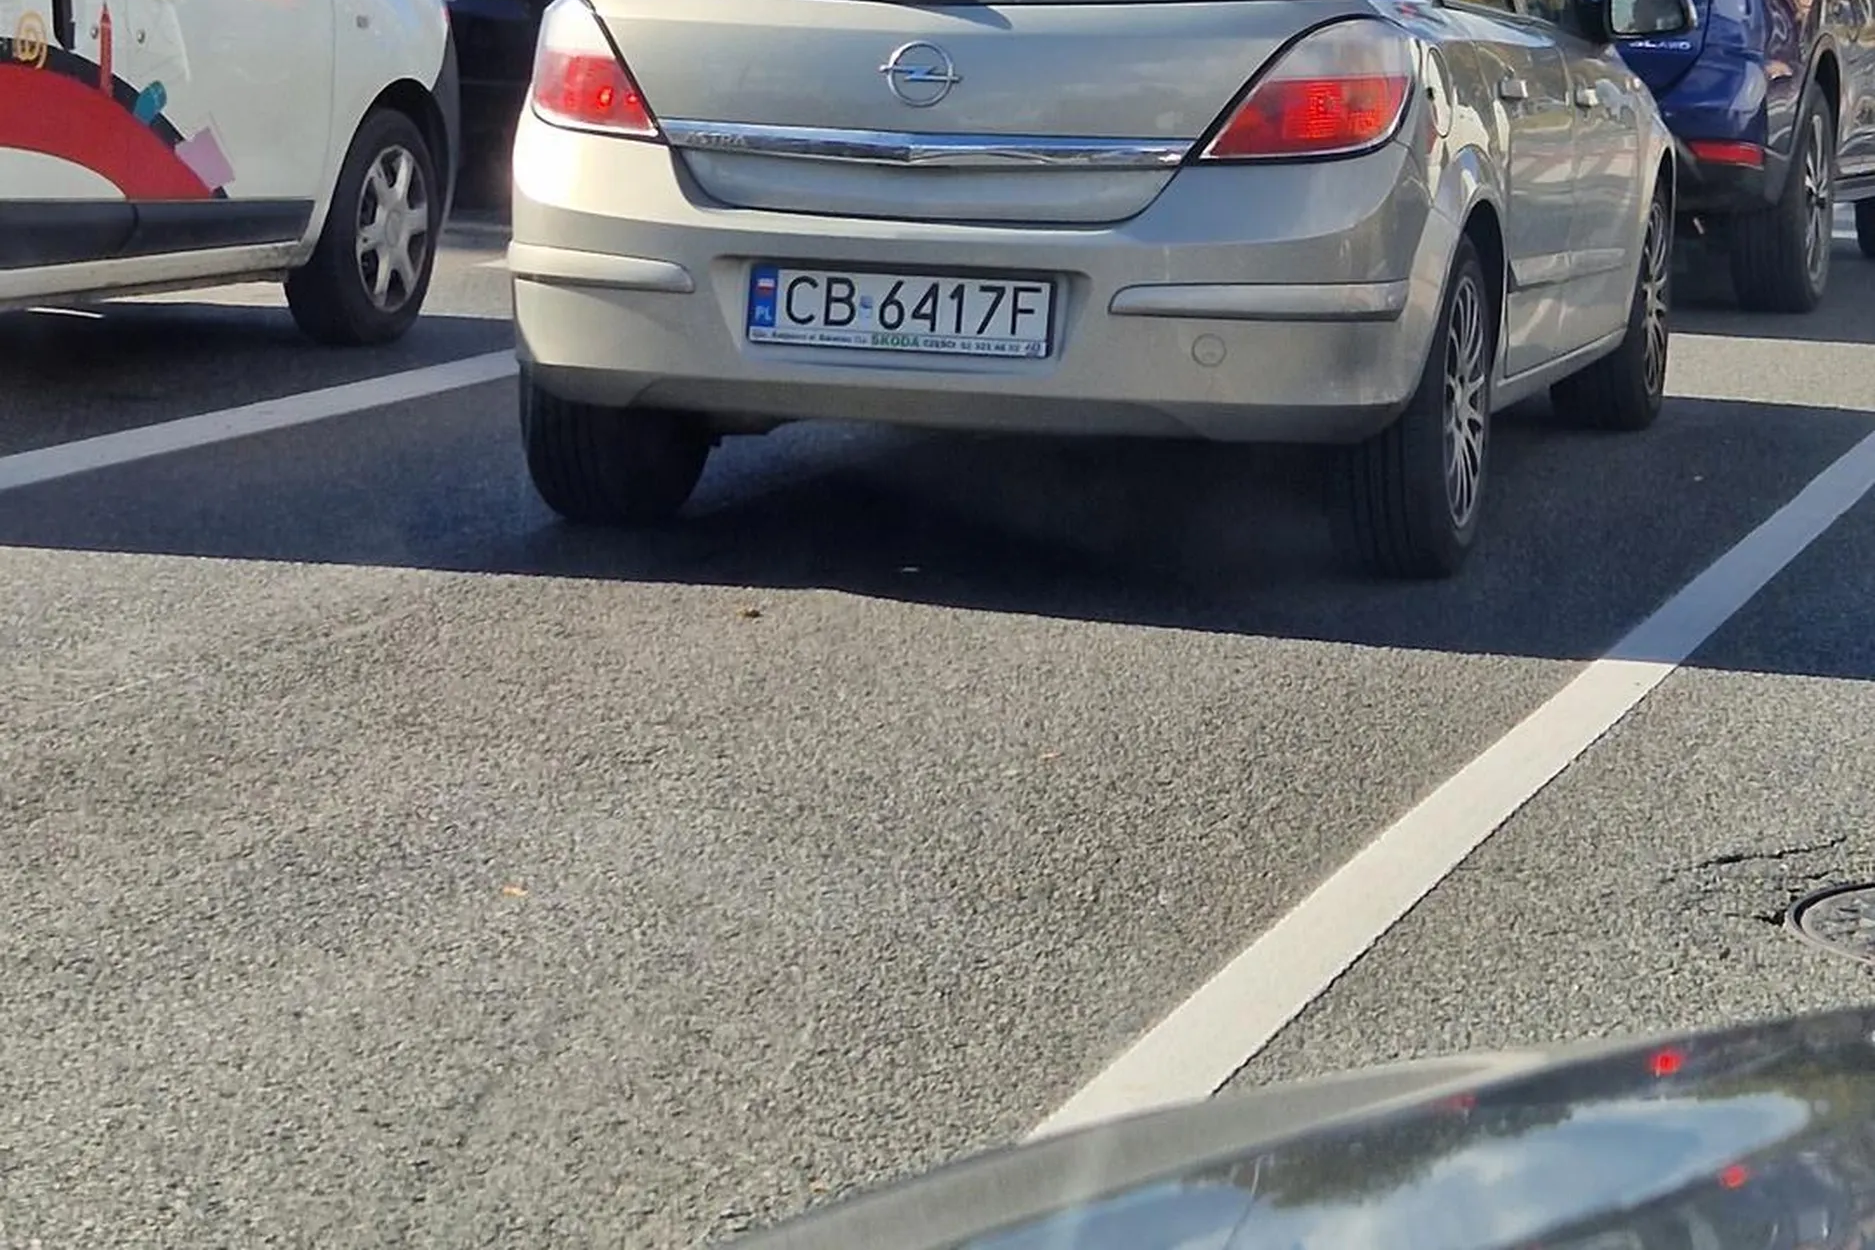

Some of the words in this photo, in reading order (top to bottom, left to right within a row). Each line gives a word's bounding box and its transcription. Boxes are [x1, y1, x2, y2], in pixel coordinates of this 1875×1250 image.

[755, 305, 772, 321] PL
[786, 275, 856, 327] CB
[878, 280, 1043, 337] 6417F
